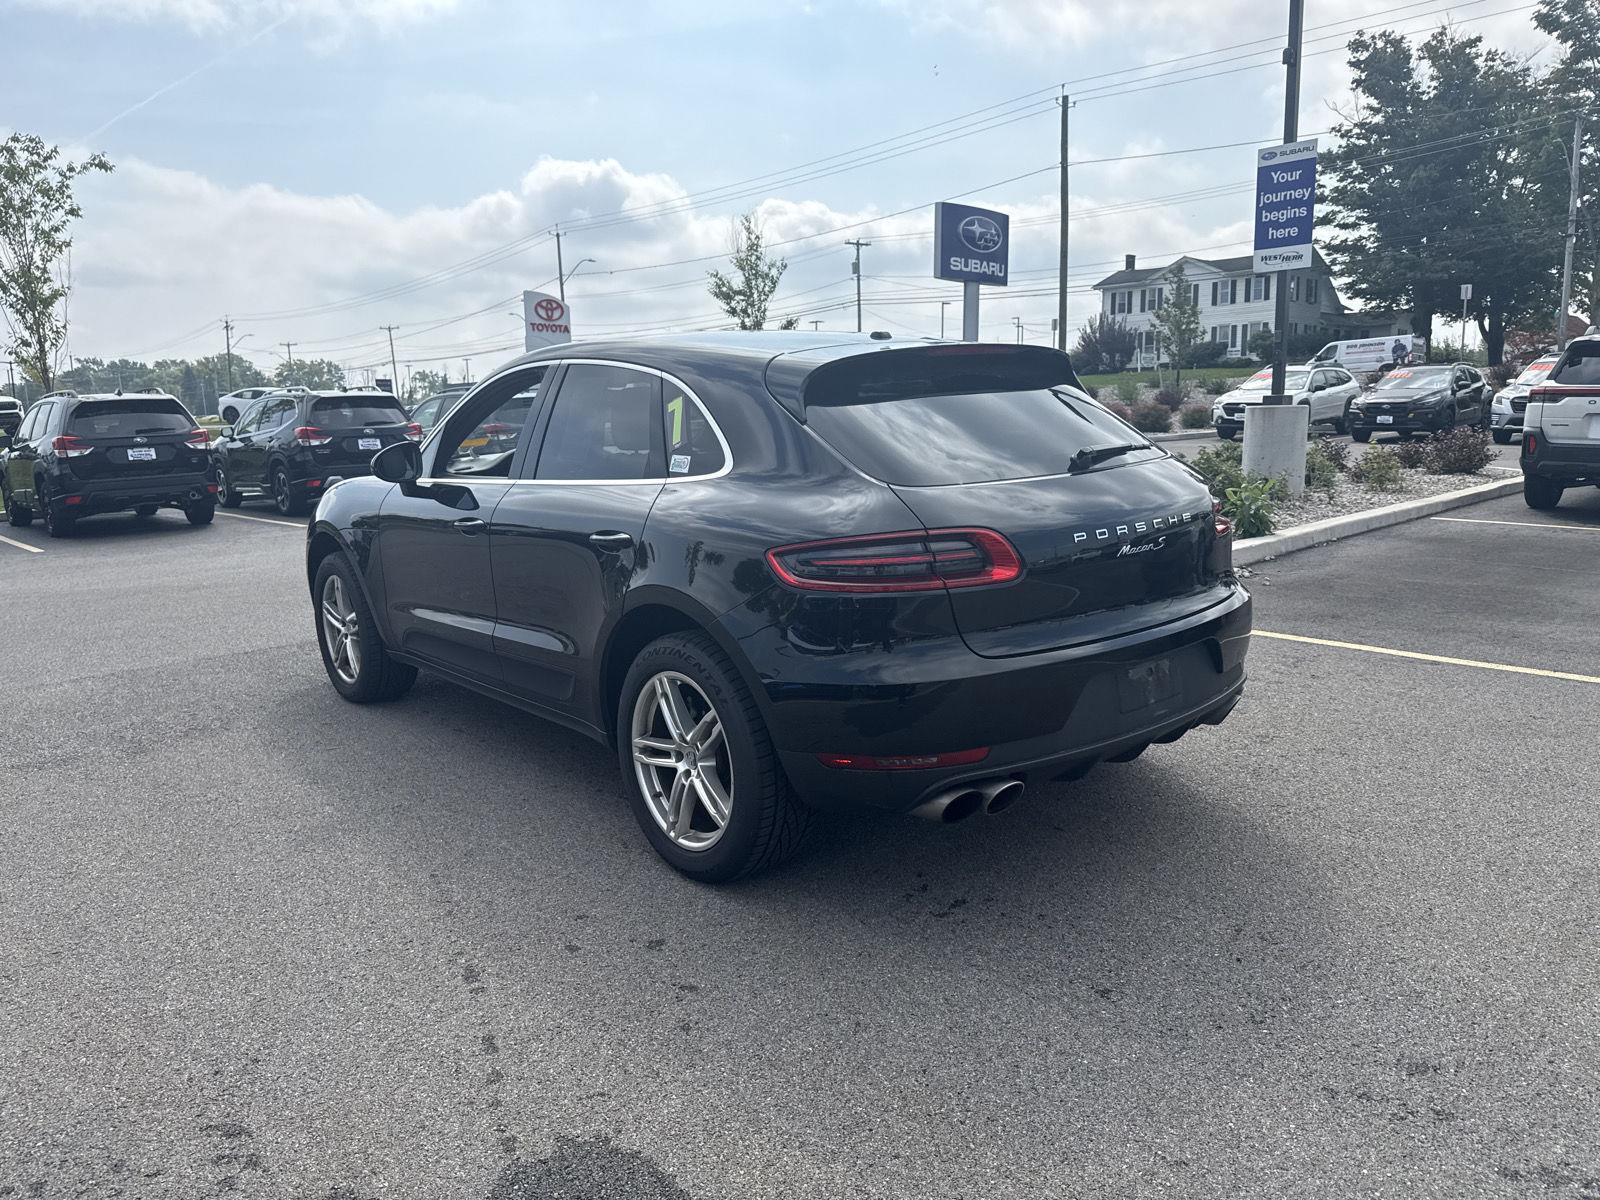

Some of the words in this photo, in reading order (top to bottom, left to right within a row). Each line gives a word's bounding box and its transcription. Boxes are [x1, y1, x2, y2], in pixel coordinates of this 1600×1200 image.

[1279, 145, 1315, 157] SUBARU
[1271, 169, 1302, 184] Your
[1259, 187, 1312, 207] journey
[1262, 206, 1308, 222] begins
[1268, 226, 1299, 240] here
[950, 256, 1005, 277] SUBARU
[530, 322, 570, 334] TOYOTA
[668, 396, 683, 446] 1
[1073, 512, 1192, 544] PORSCHE
[1117, 543, 1154, 557] Macan
[1153, 536, 1167, 551] S
